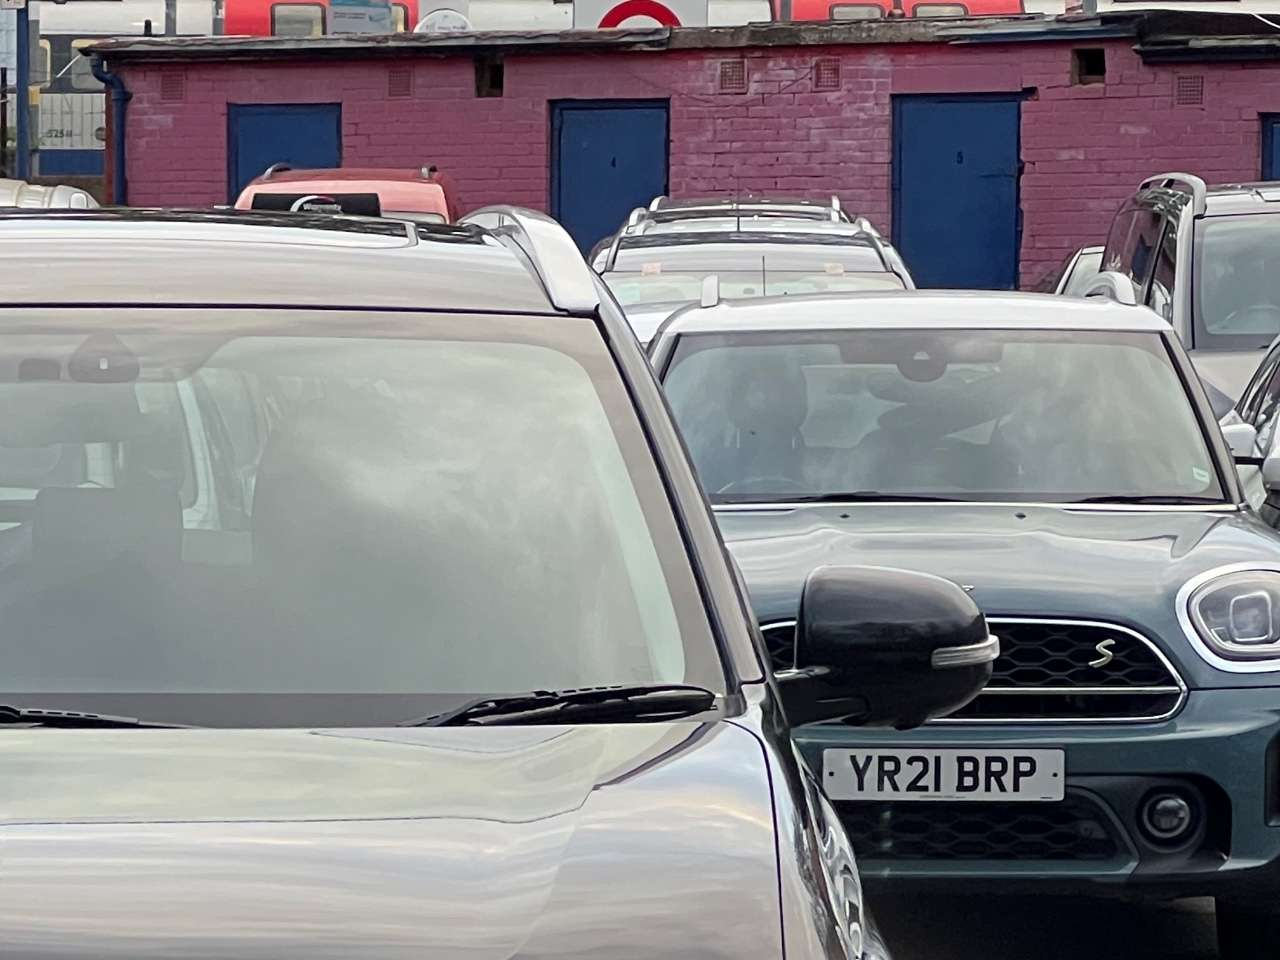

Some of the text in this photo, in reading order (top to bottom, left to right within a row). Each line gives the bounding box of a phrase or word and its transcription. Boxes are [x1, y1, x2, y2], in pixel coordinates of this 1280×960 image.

[1088, 638, 1116, 668] S
[849, 754, 1038, 793] YR21 BRP
